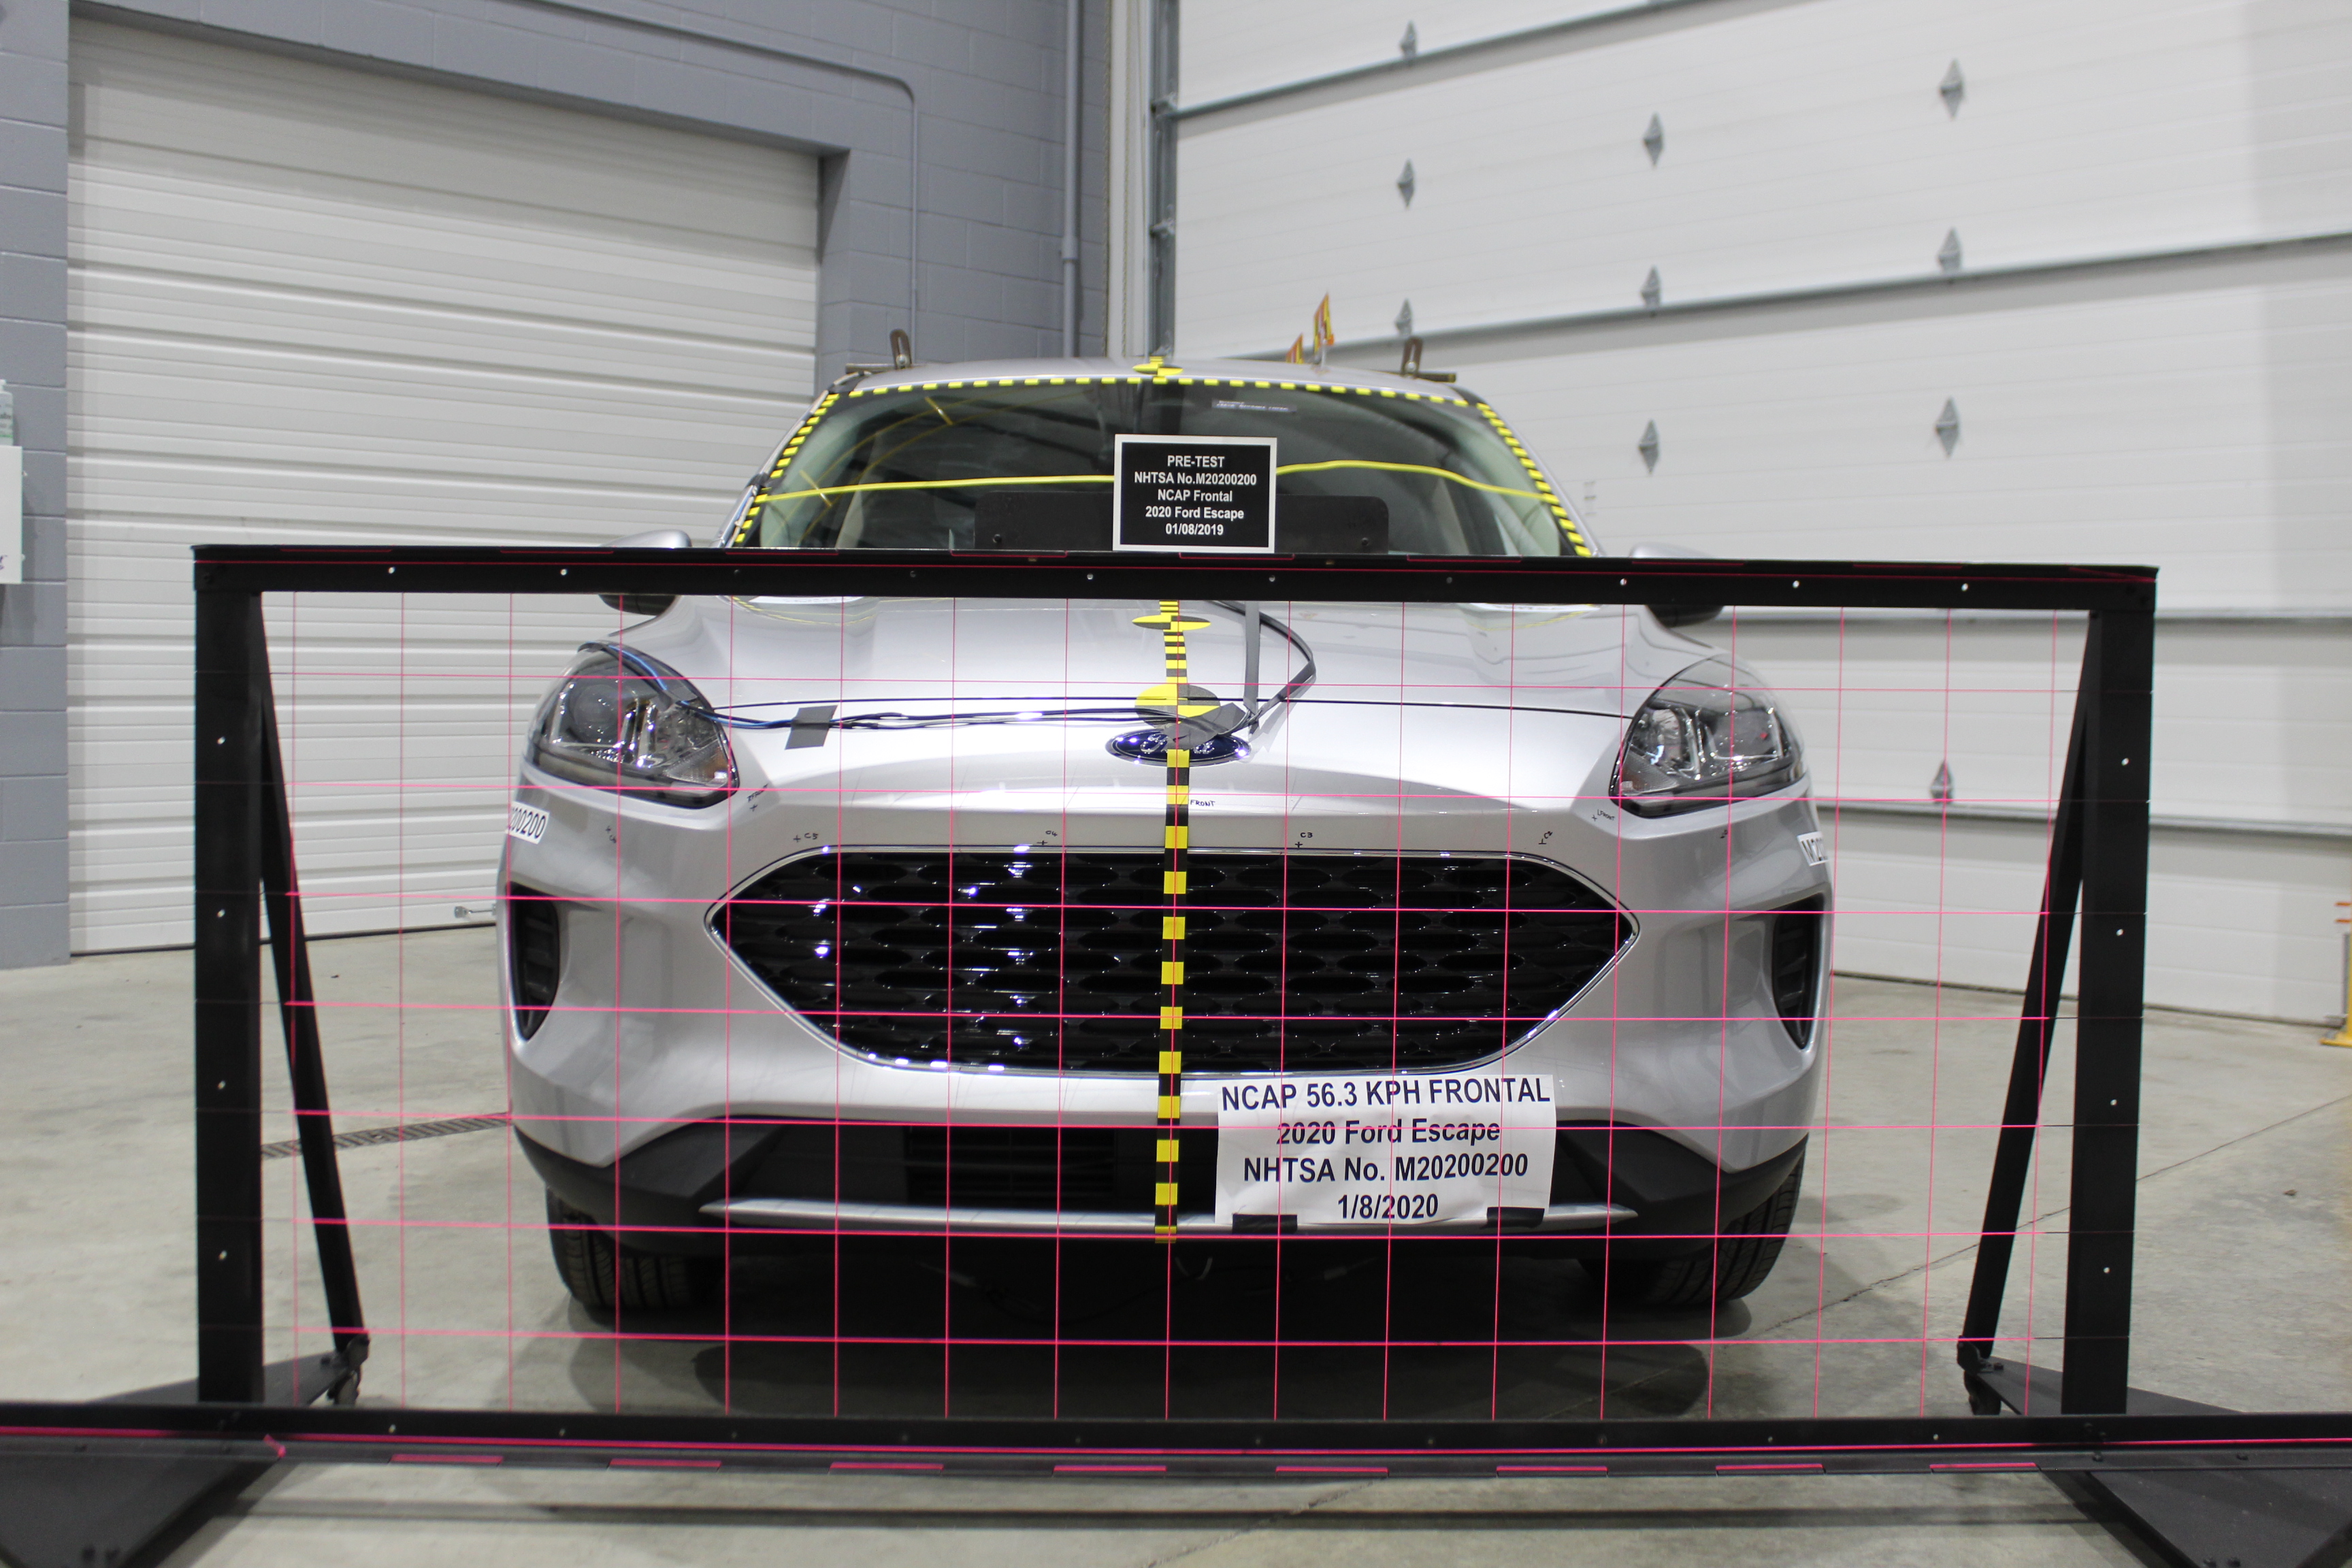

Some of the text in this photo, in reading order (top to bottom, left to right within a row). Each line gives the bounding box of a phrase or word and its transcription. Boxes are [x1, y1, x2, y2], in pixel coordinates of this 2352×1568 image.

[1167, 455, 1225, 468] PRE-TEST
[1134, 472, 1257, 485] NHTSA No.M20200200
[1158, 489, 1232, 502] NCAP Frontal
[1145, 506, 1244, 521] 2020 Ford Escape
[1166, 523, 1224, 535] 01/08/2019
[1222, 1078, 1550, 1111] NCAP 56.3 KPH FRONTAL
[1277, 1118, 1501, 1146] 2020 Ford Escape
[1244, 1154, 1528, 1182] NHTSA No. M20200200
[1338, 1194, 1438, 1220] 1/8/2020
